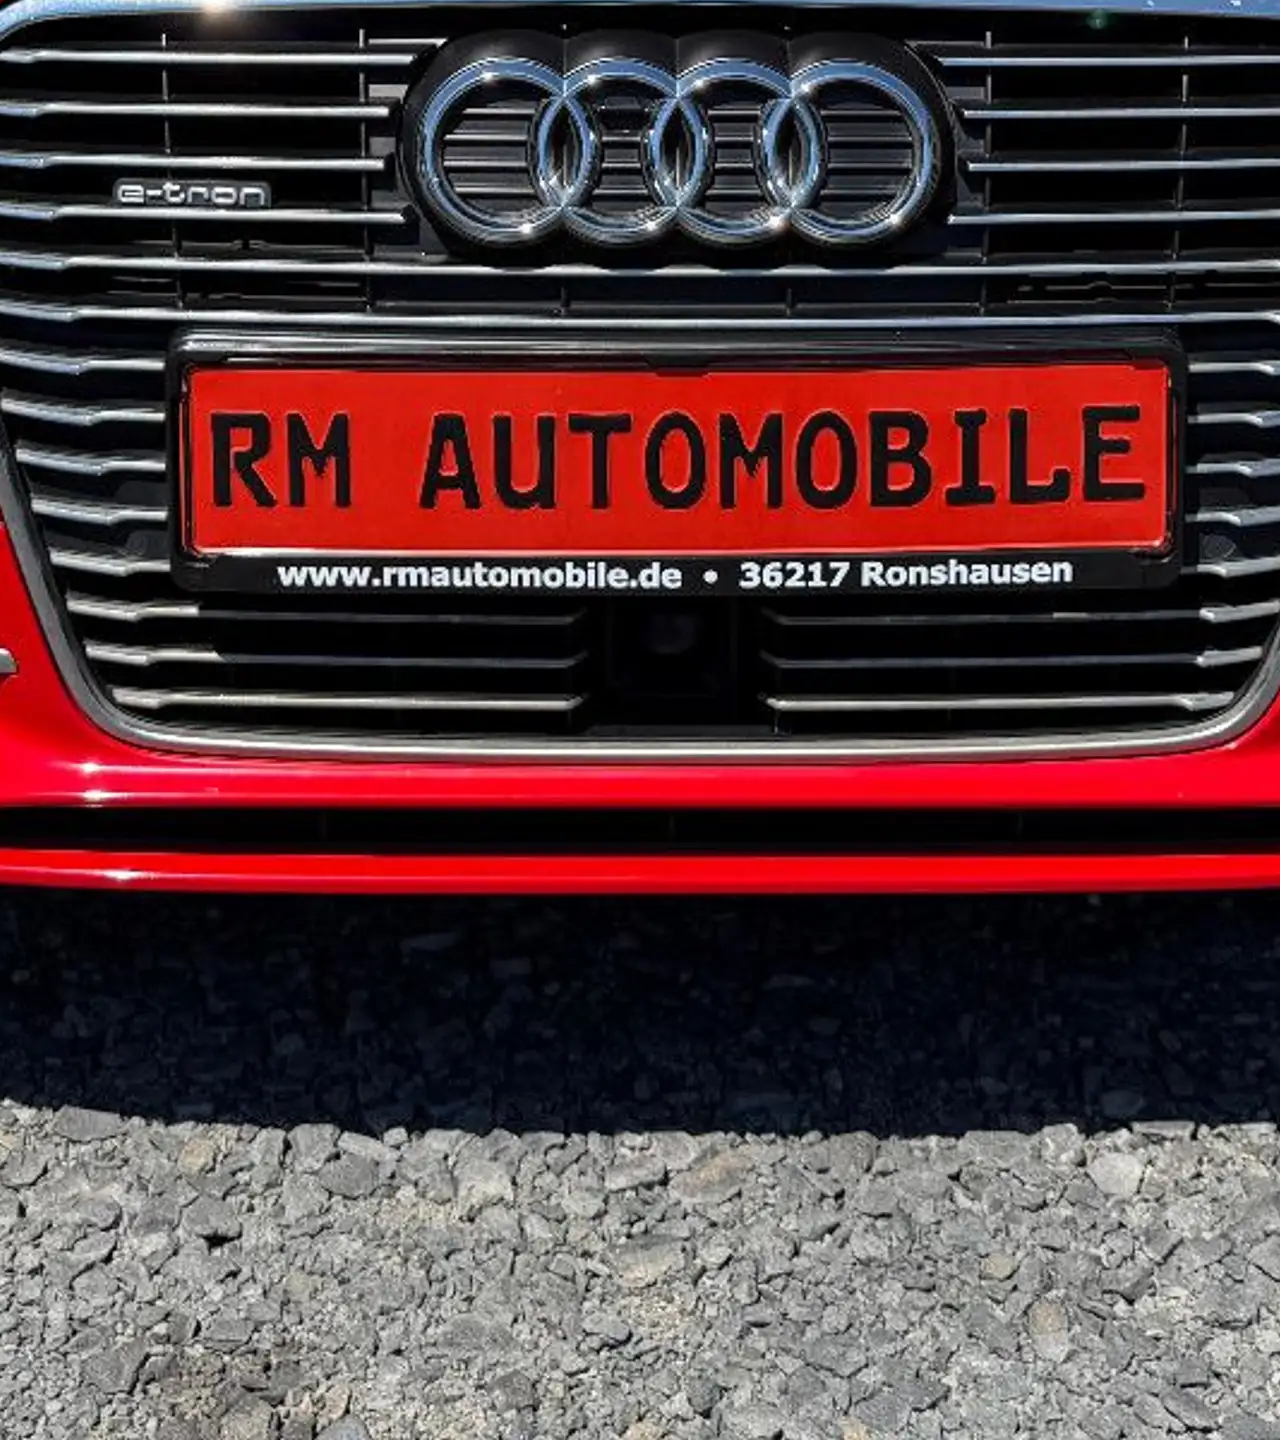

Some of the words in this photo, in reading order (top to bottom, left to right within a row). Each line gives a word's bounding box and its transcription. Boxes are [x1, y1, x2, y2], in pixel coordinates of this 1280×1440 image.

[117, 181, 265, 206] e-tron
[211, 413, 352, 509] RM
[419, 405, 1146, 511] AUTOMOBILE
[277, 561, 682, 589] www.rmautomobile.de
[739, 561, 850, 588] 36217
[861, 558, 1073, 587] Ronshausen
